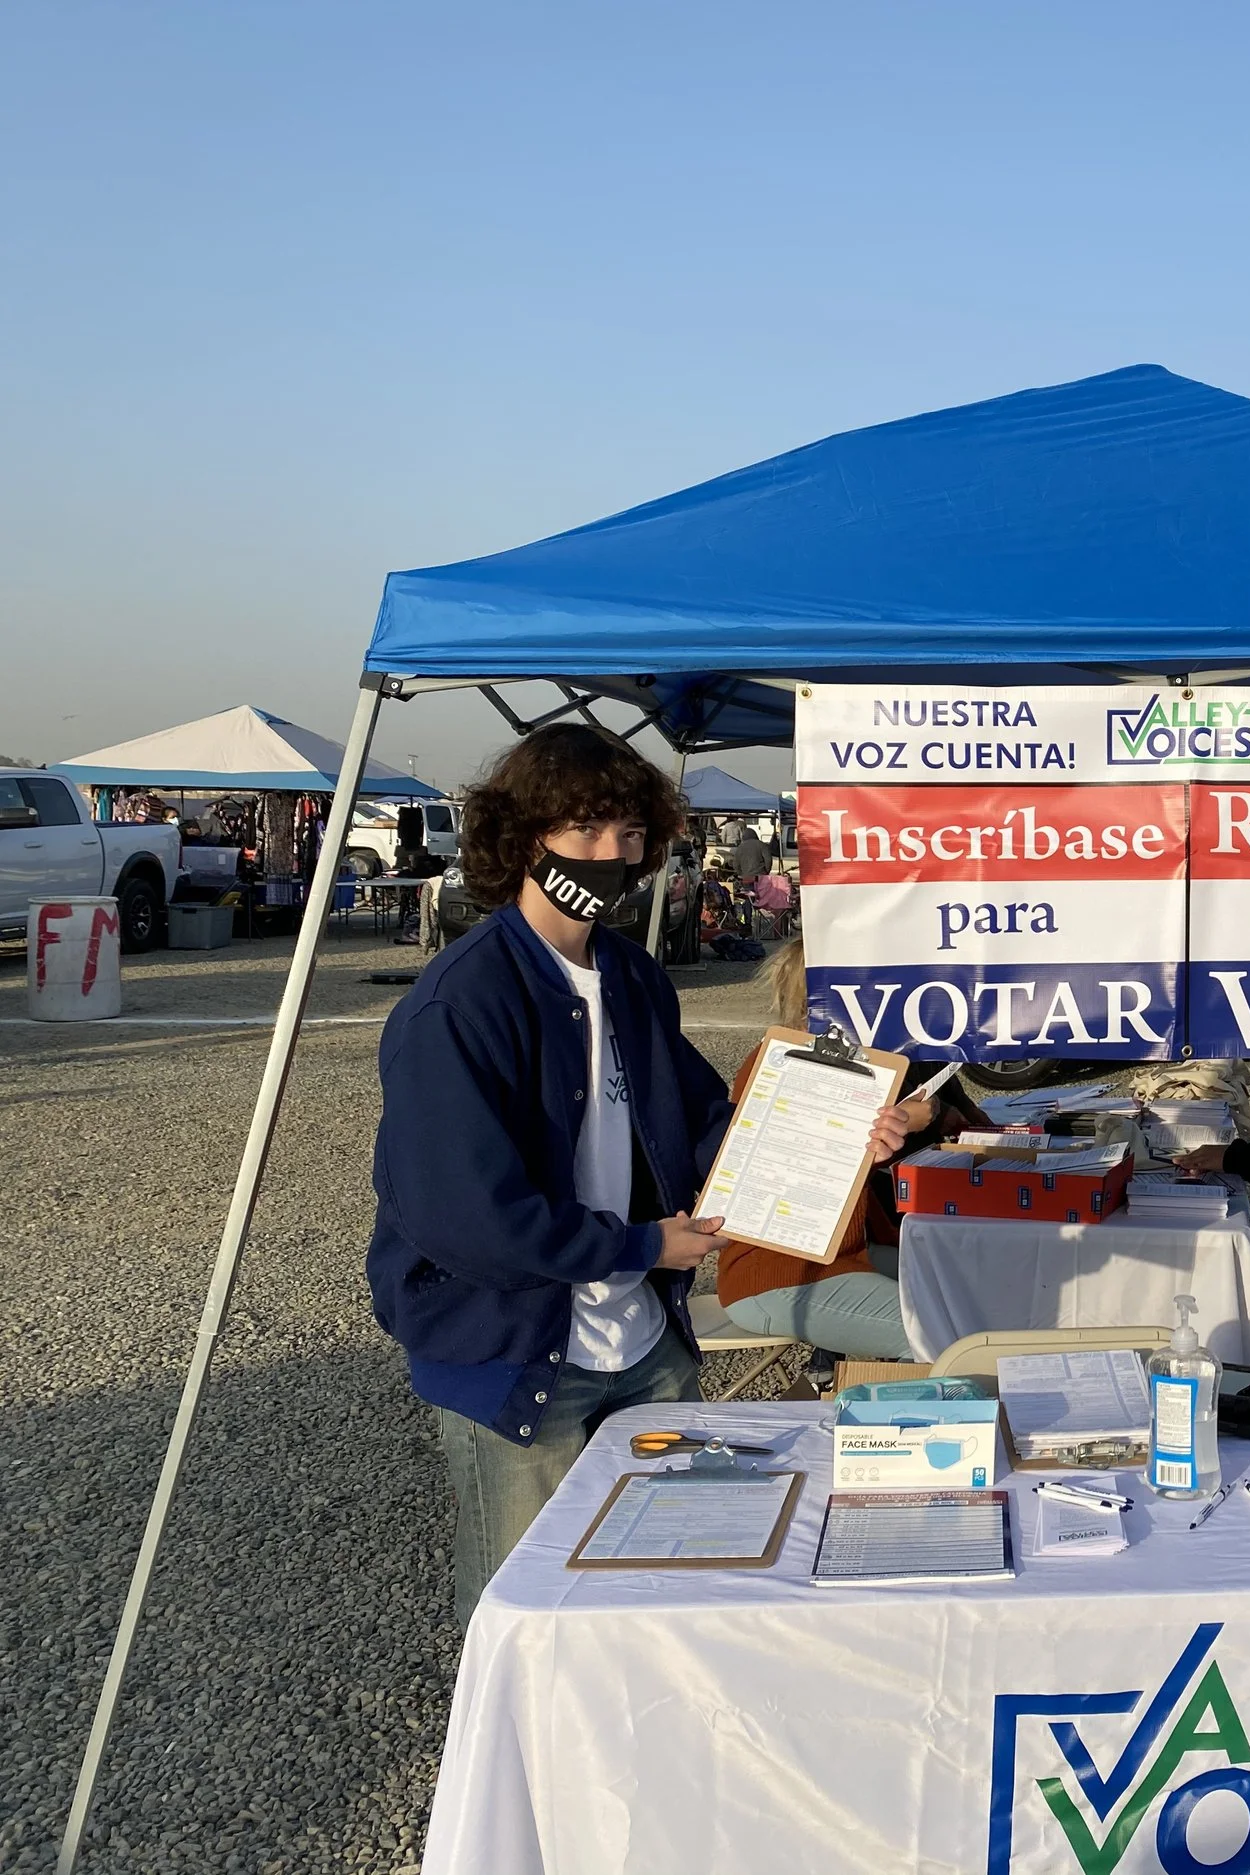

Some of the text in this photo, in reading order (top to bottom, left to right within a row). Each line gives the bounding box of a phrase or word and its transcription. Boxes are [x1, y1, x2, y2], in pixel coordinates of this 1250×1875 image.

[874, 700, 1037, 727] NUESTRA
[1120, 694, 1249, 738] VALLEY
[830, 742, 1075, 769] VOZ CUENTA!
[821, 806, 1165, 864] Inscríbase
[543, 867, 604, 918] VOTE
[936, 901, 1058, 950] para
[830, 981, 1166, 1047] VOTAR
[842, 1440, 867, 1448] FACE
[869, 1440, 897, 1448] MASK
[975, 1468, 984, 1476] 50
